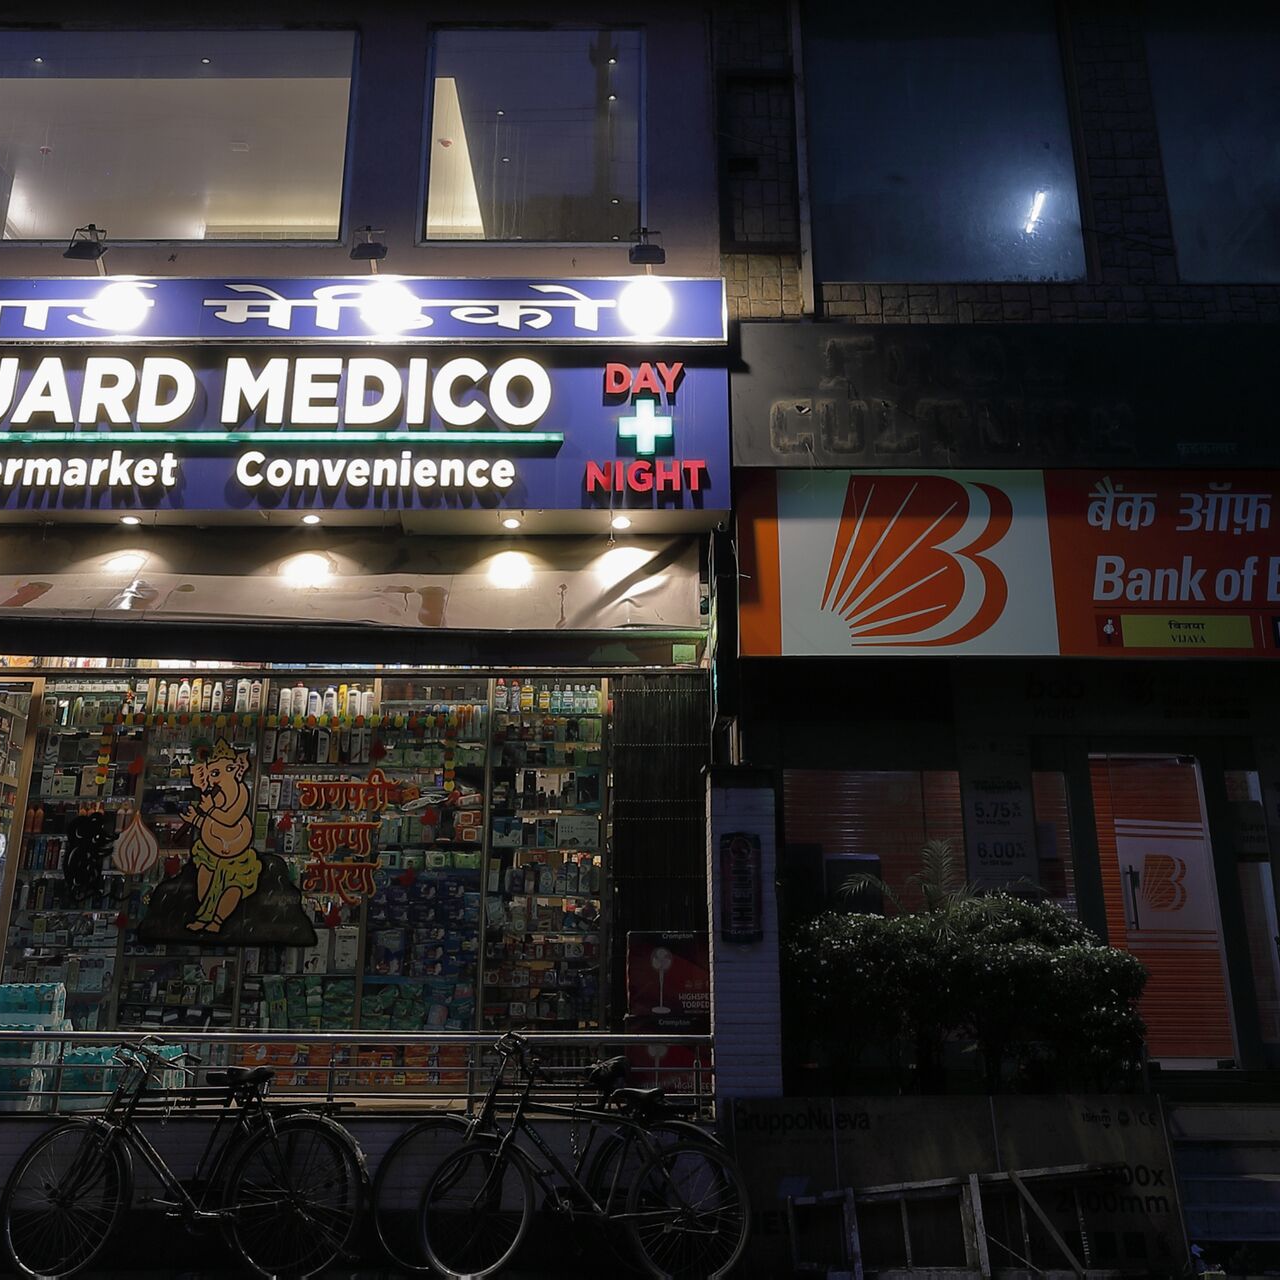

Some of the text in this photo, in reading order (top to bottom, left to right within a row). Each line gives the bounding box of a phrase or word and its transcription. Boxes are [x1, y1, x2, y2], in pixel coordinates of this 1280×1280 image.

[219, 356, 553, 426] MEDICO
[604, 361, 685, 395] DAY
[235, 449, 516, 489] Convenience
[584, 459, 708, 493] NIGHT
[1086, 475, 1157, 532] बैंक
[1091, 555, 1214, 603] Bank
[1214, 554, 1257, 603] of
[1171, 634, 1207, 645] VIJAYA
